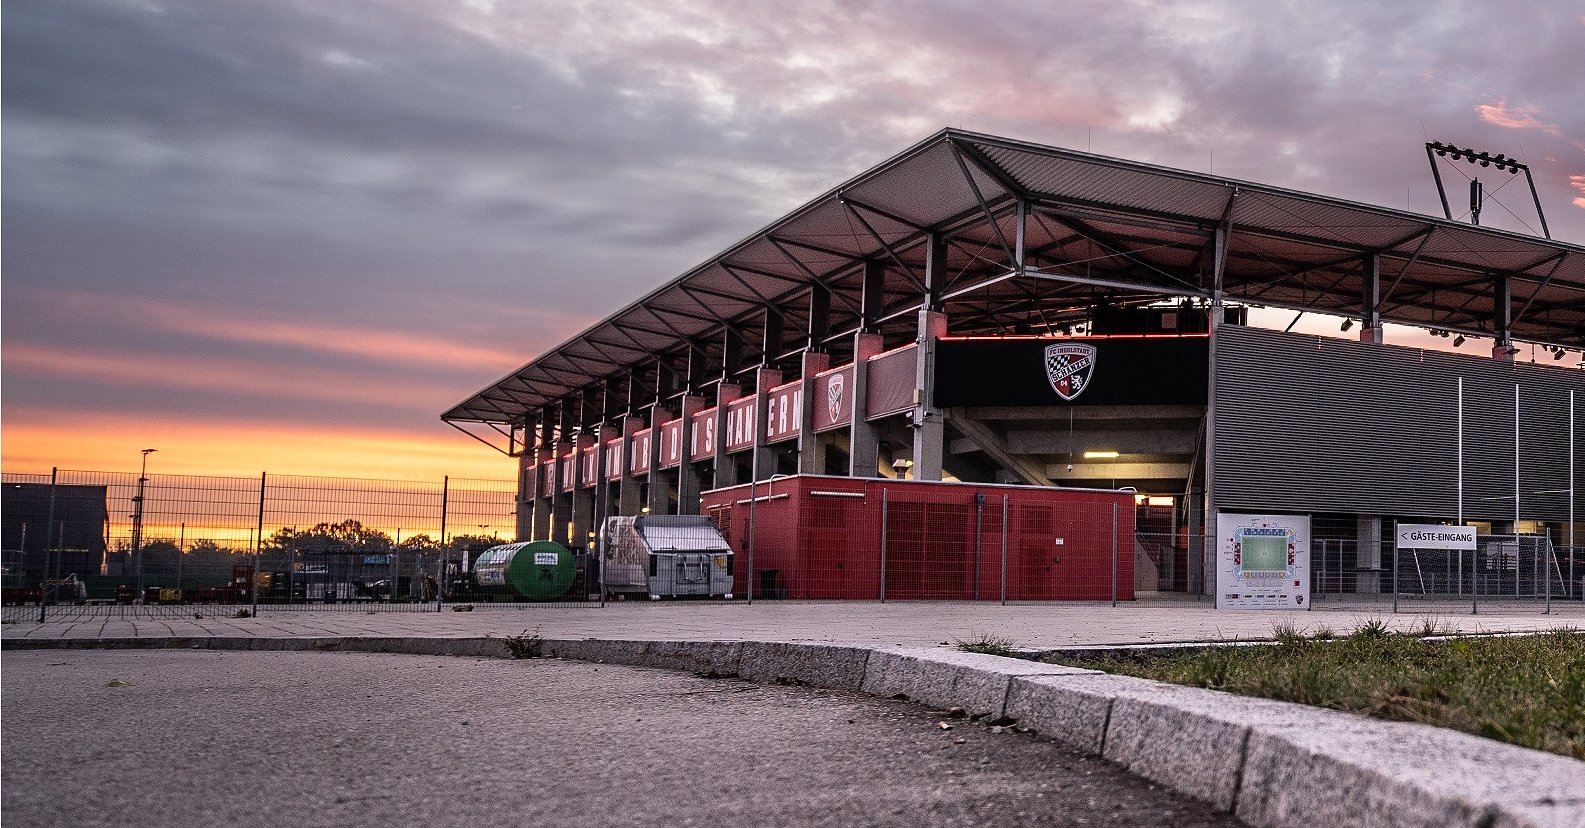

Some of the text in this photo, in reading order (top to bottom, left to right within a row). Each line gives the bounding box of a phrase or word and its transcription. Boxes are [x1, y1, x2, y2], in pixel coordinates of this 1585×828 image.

[642, 432, 663, 469] BI
[670, 422, 698, 460] DN
[705, 389, 802, 453] SHANERN
[1410, 530, 1473, 542] GÄSTE-EINGANG
